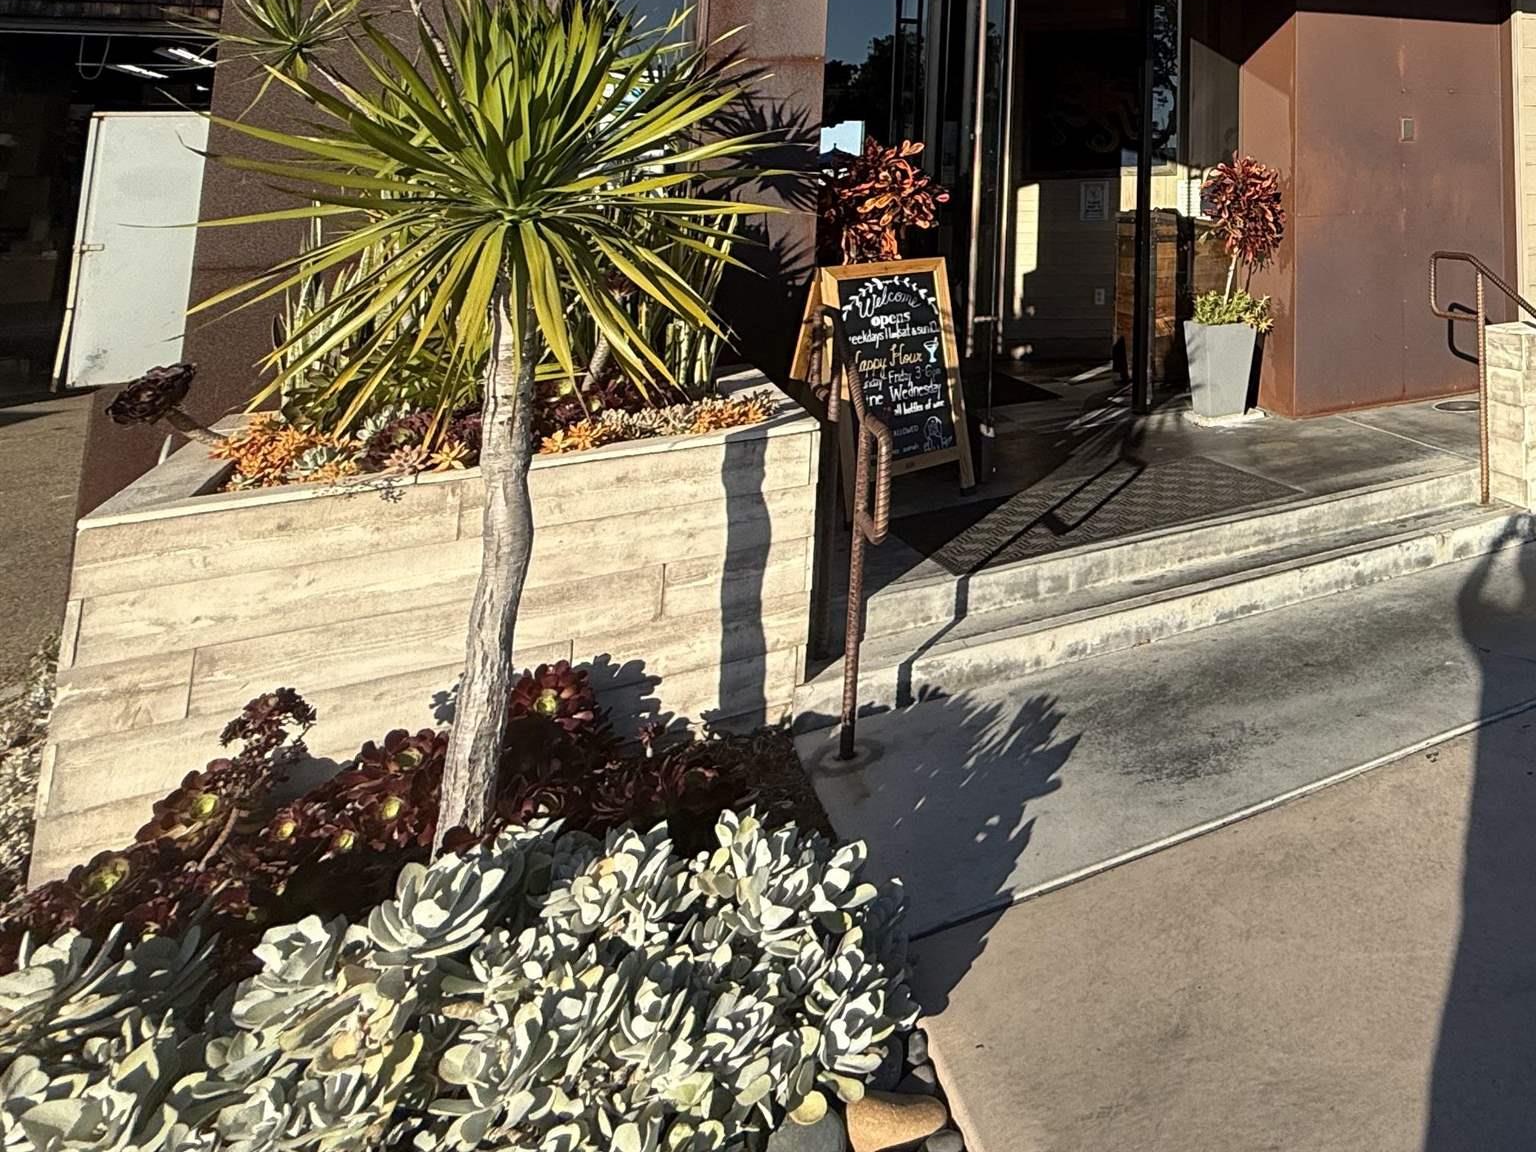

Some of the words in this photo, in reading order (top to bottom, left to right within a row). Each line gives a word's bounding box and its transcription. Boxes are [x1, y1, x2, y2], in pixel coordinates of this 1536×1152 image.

[859, 286, 921, 318] Welcome
[870, 311, 911, 329] opens
[848, 329, 885, 349] eekdays
[889, 343, 923, 366] Hour
[888, 378, 942, 402] Wednesday
